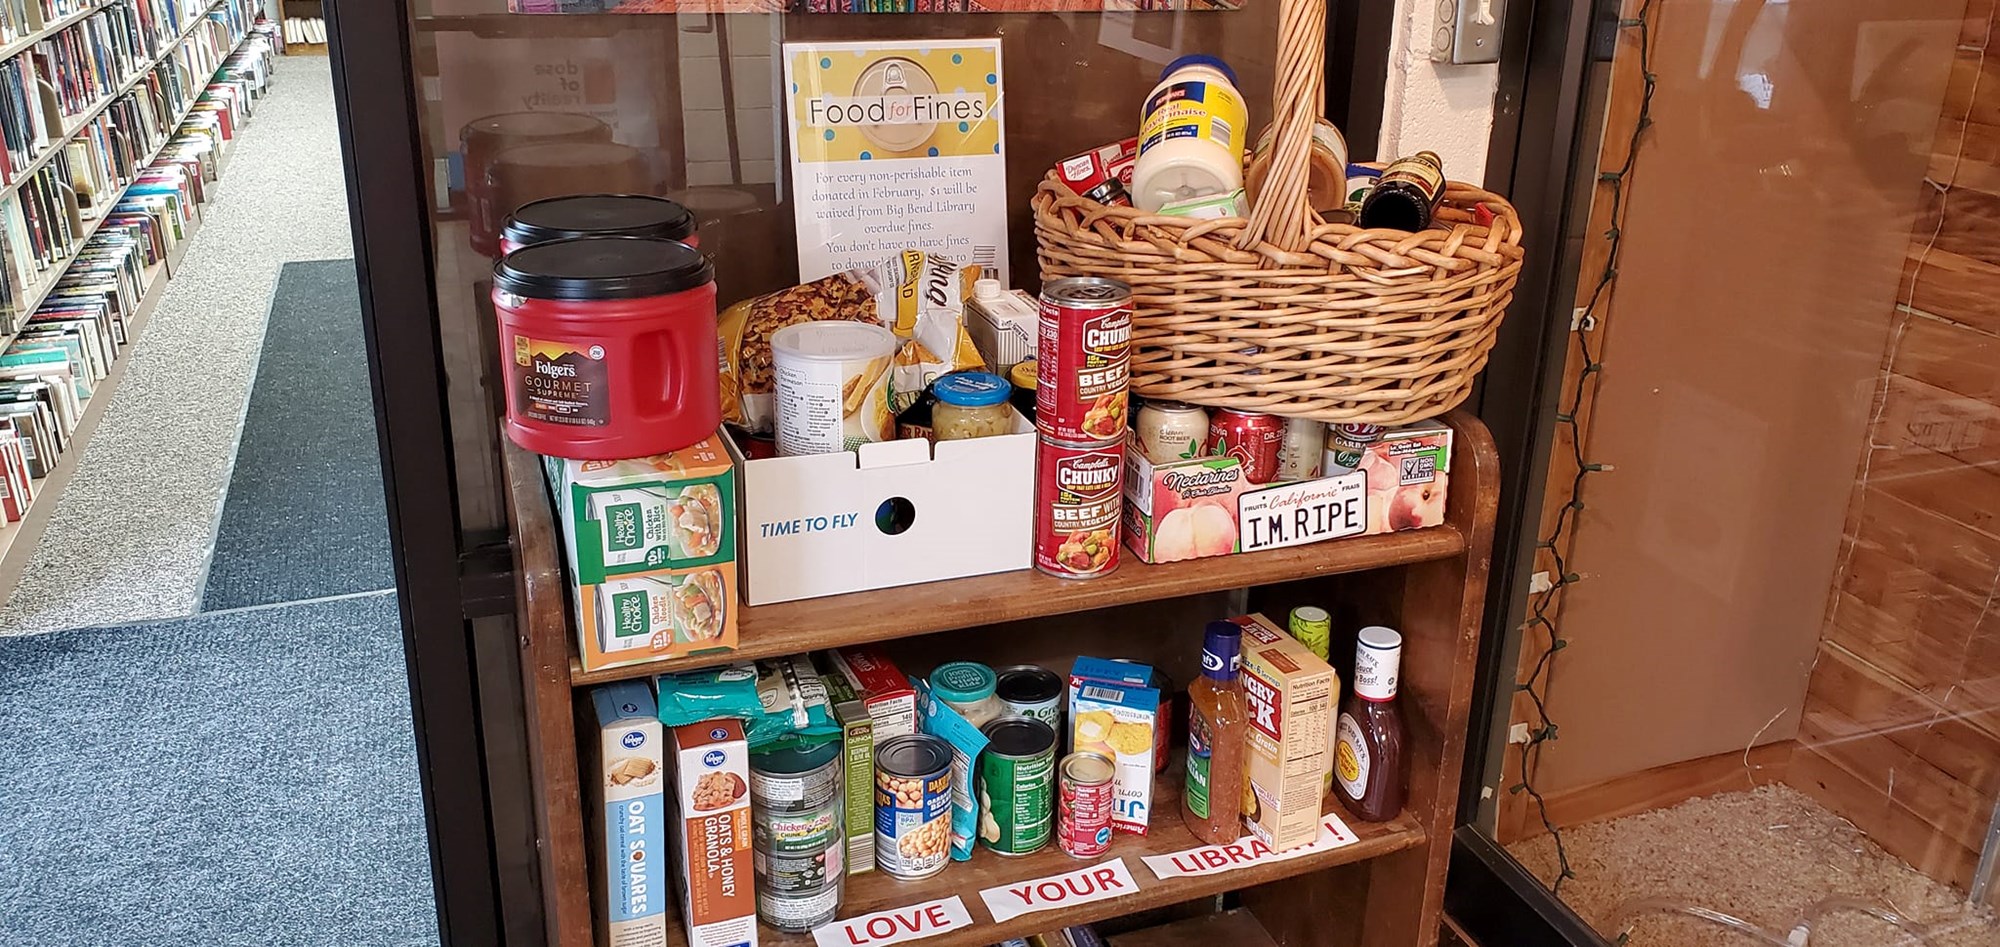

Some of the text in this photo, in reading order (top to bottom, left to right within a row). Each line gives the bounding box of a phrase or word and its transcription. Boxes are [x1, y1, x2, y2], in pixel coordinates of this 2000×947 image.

[810, 95, 984, 124] Food for Fines
[815, 166, 972, 186] For every non-perishable item
[812, 183, 977, 202] donated in February, $1 will be
[816, 201, 976, 220] waived from Big Bend Library
[864, 220, 934, 235] overdue fines.
[826, 234, 970, 254] You don't have to have fines
[831, 259, 842, 271] to
[956, 252, 967, 262] to
[1087, 325, 1132, 348] CHUNK
[535, 355, 576, 379] Folgers
[1079, 364, 1123, 387] BEEF
[525, 375, 592, 392] GOURMET
[536, 389, 577, 399] SUPREME
[1335, 437, 1367, 450] GARBA
[1060, 465, 1118, 486] CHUNKY
[1163, 468, 1240, 492] Nectarines
[1244, 503, 1268, 513] FRUITS
[1341, 483, 1361, 492] FRAIS
[646, 509, 654, 540] Chicken
[654, 505, 662, 524] Rice
[1053, 505, 1103, 521] BEEF
[1054, 520, 1081, 529] COUNTRY
[1248, 497, 1360, 550] I.M. RIPE
[615, 511, 627, 545] Healthy
[624, 507, 634, 547] Choice
[761, 512, 859, 538] TIME TO FLY
[622, 598, 632, 630] Healthy
[631, 595, 641, 632] Choice
[651, 596, 660, 625] Chicken
[659, 596, 667, 622] Noodle
[1240, 670, 1276, 705] NGRY
[1292, 677, 1330, 690] Nutrition Facts
[1359, 675, 1378, 684] Boss!
[901, 712, 913, 721] 140
[1245, 691, 1278, 734] CK
[1017, 761, 1045, 771] Nutrition
[931, 793, 952, 811] BEAN
[771, 821, 808, 832] Chicken
[1112, 821, 1146, 835] Americ
[704, 817, 720, 873] GRANOLA
[718, 814, 735, 897] OATS & HONEY
[628, 800, 647, 915] OAT SQUARES
[844, 904, 952, 947] LOVE
[1009, 868, 1125, 906] YOUR
[1171, 839, 1316, 875] LIBRA
